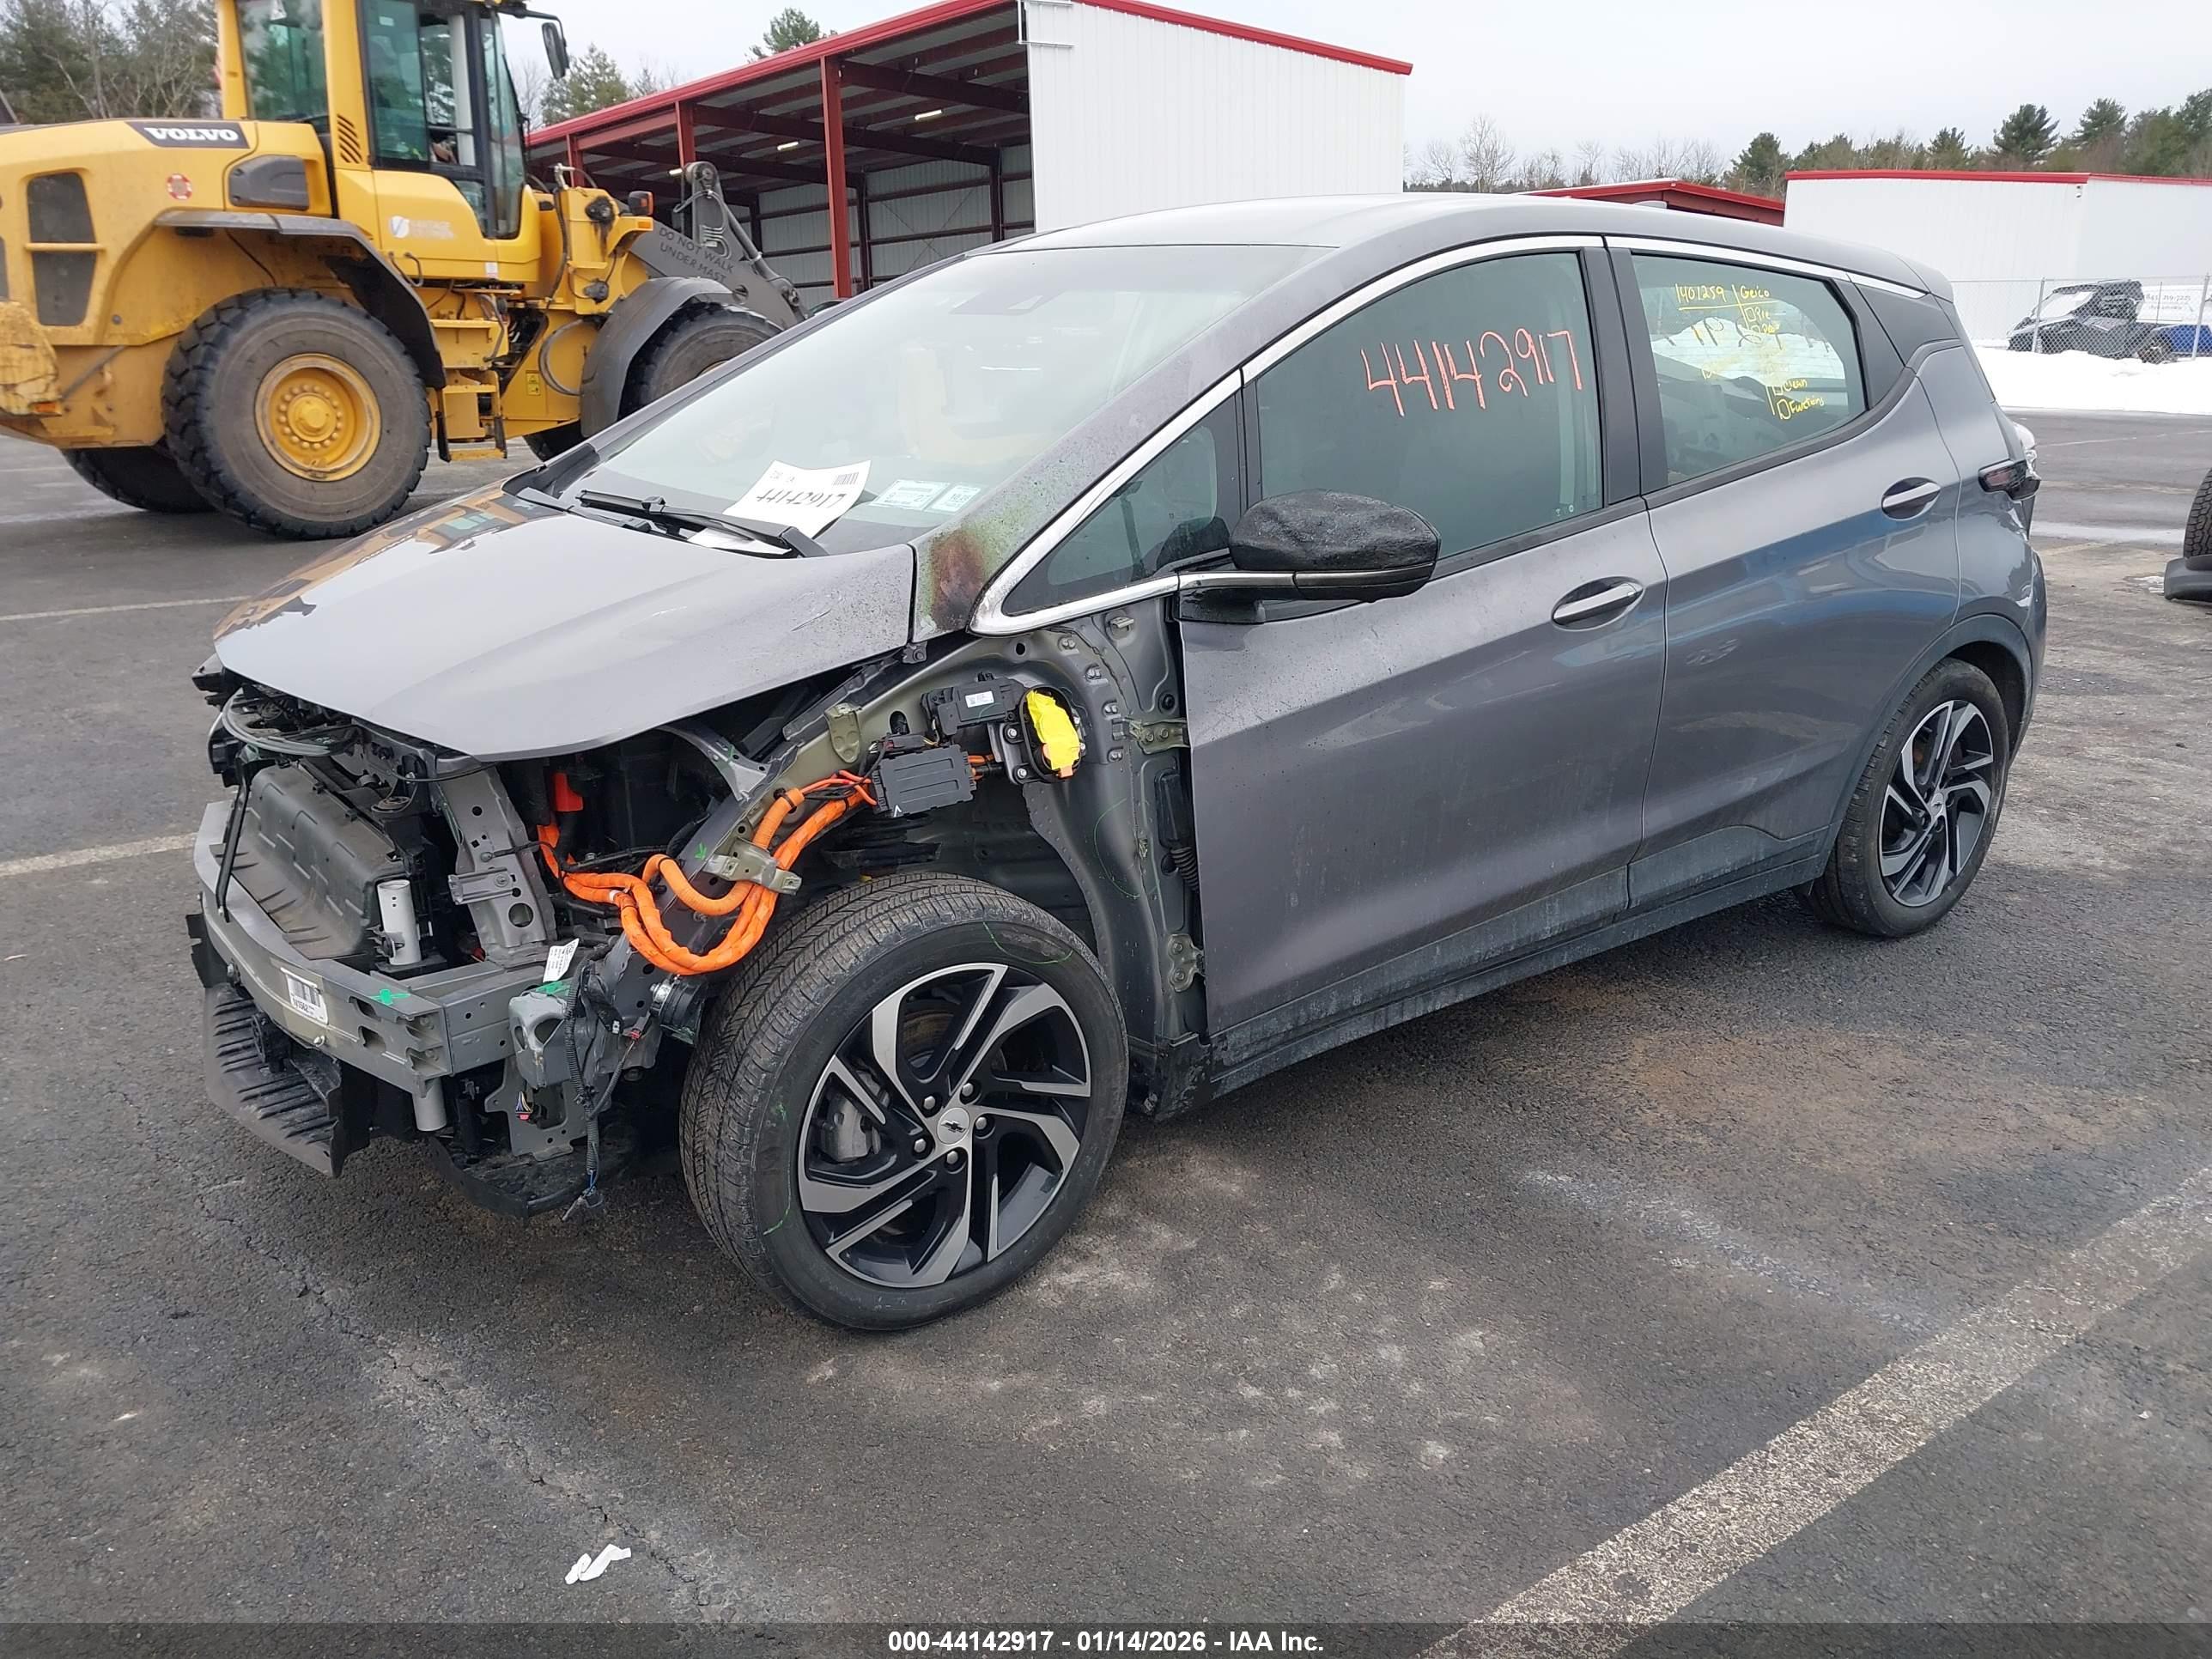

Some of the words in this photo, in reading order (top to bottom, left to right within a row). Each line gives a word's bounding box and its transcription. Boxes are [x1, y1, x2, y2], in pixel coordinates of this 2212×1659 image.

[143, 127, 239, 142] VOLVO
[659, 227, 675, 240] DO
[677, 236, 702, 255] NOT
[704, 251, 733, 274] WALK
[660, 242, 696, 269] UNDER
[697, 263, 726, 283] MAST
[1359, 328, 1583, 417] 44142917
[756, 487, 848, 508] 44142917
